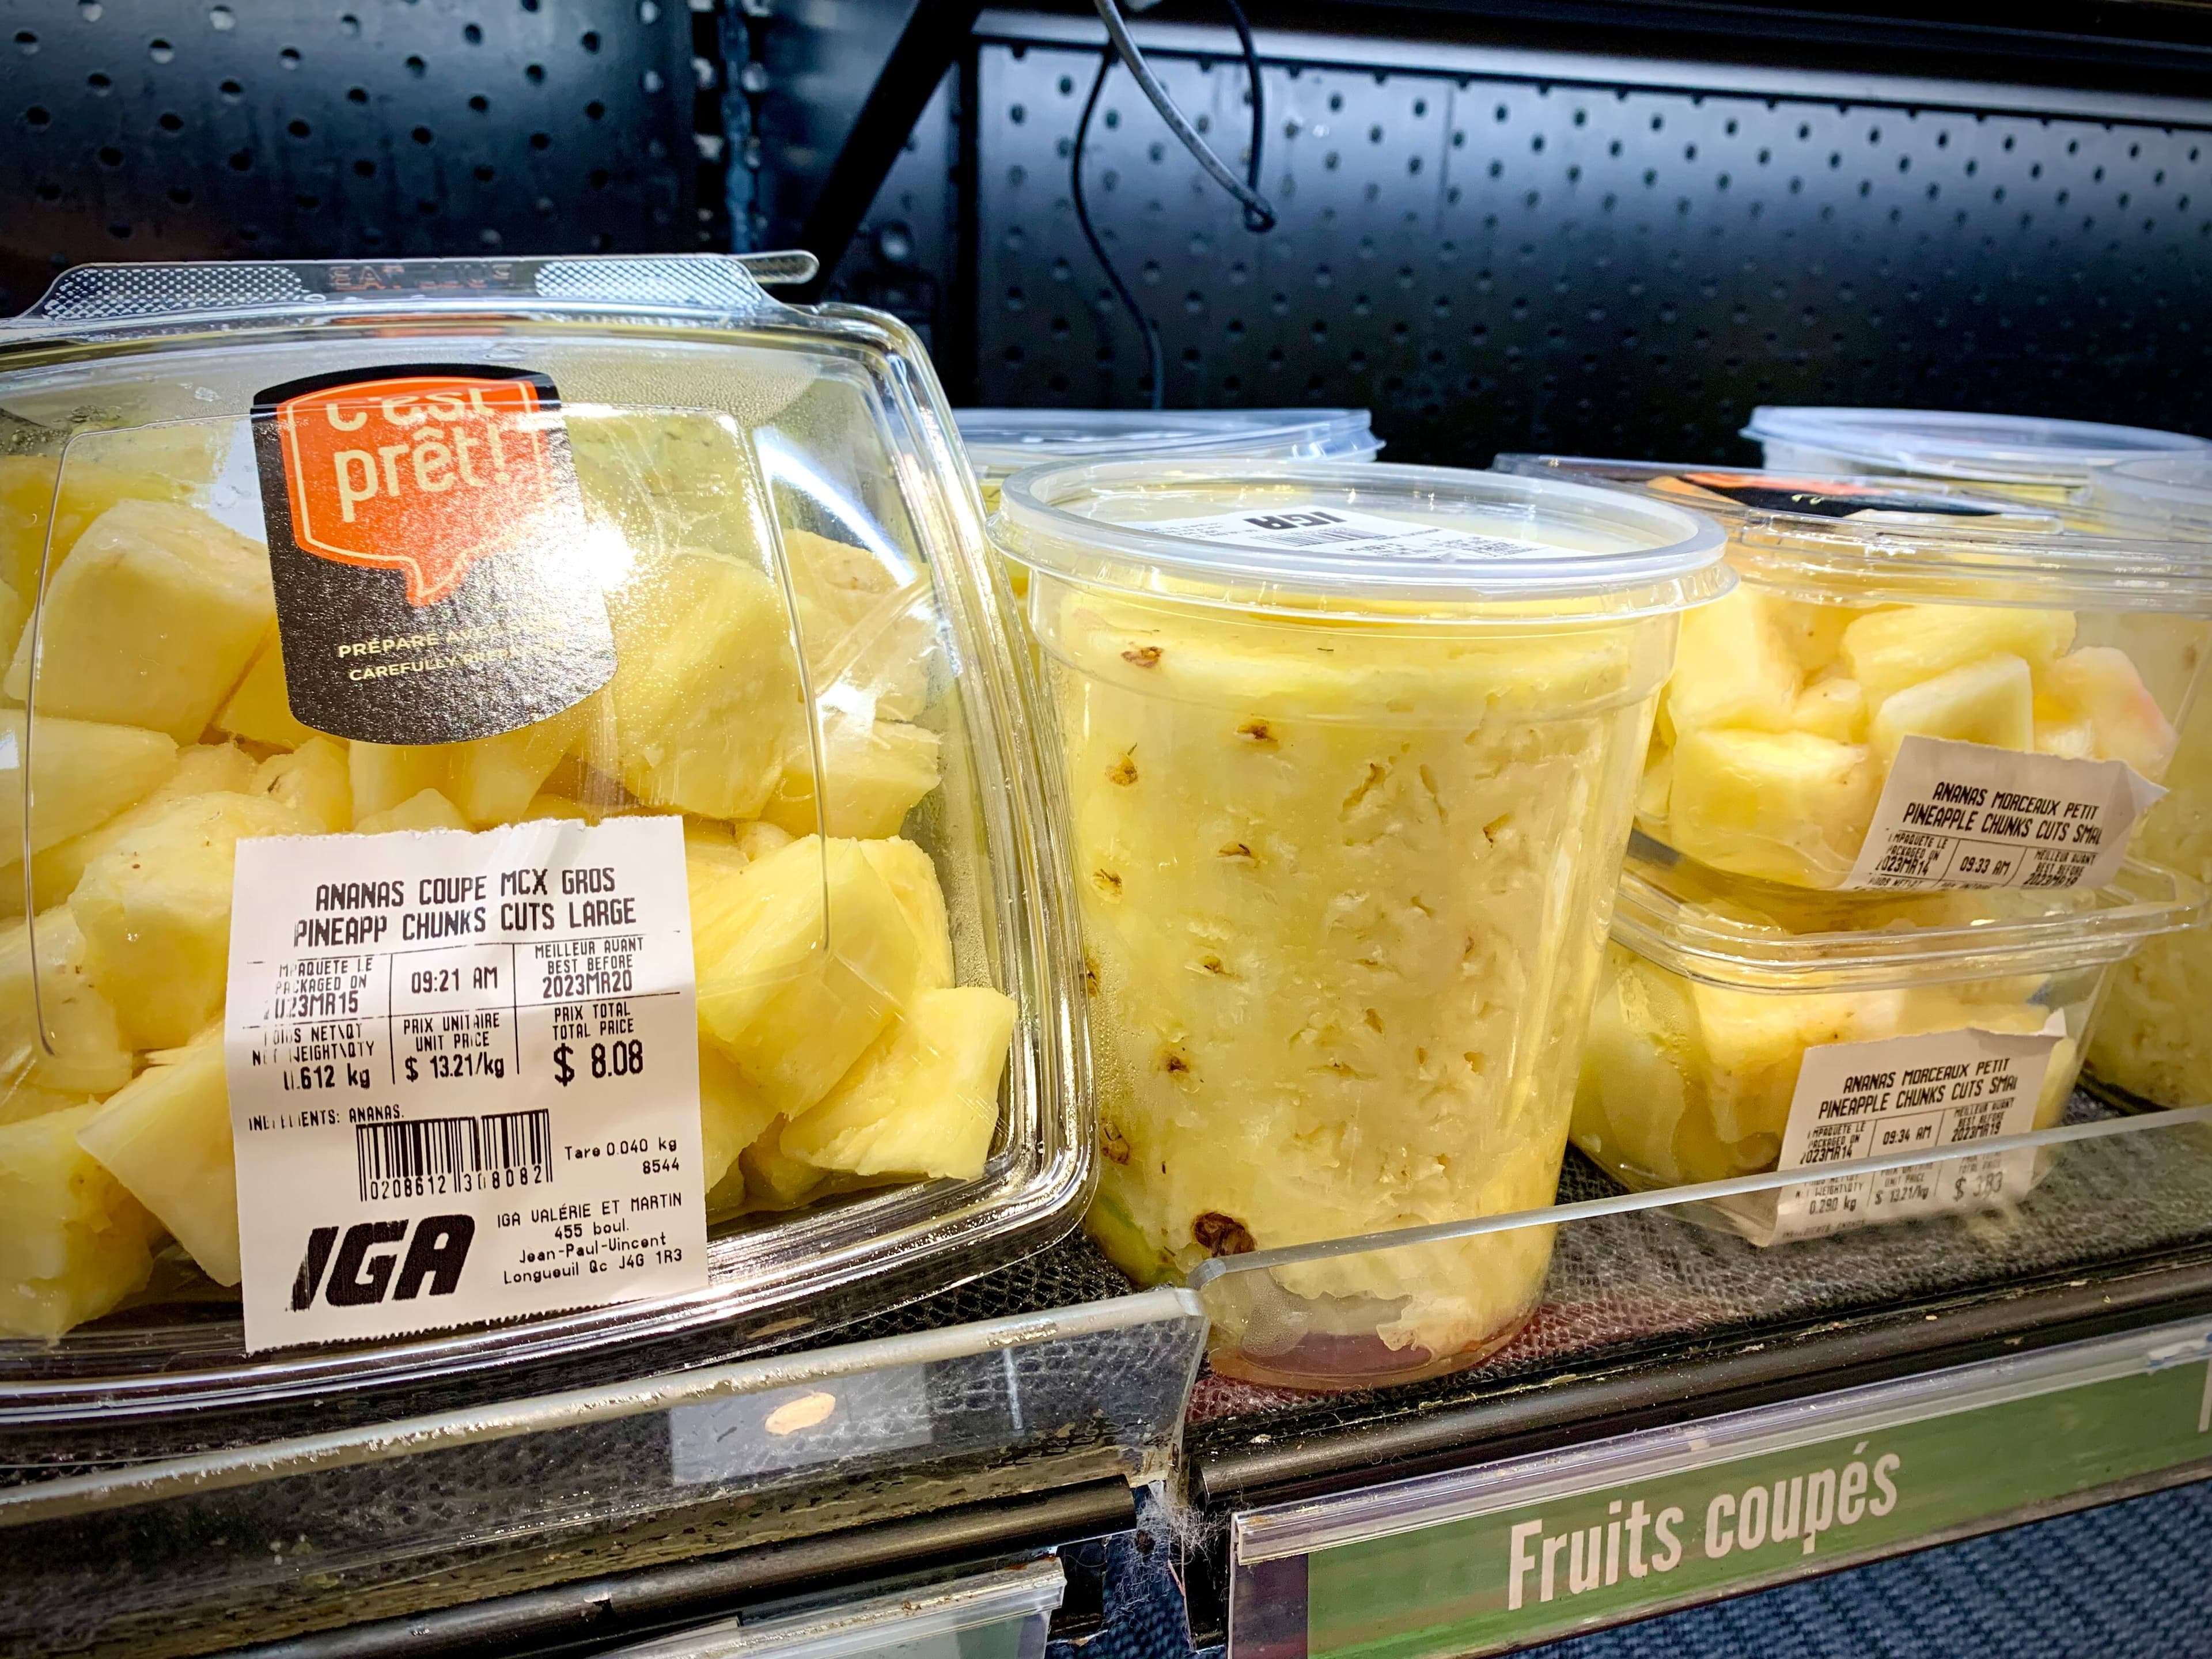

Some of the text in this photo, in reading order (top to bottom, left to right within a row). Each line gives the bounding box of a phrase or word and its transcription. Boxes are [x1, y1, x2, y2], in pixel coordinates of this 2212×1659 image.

[334, 423, 512, 523] prêt!
[1243, 511, 1348, 530] IGA
[349, 656, 459, 681] CAREFULLY
[1933, 782, 2100, 820] ANANAS MORCEAUX PETIT
[1903, 802, 1979, 831] PINEAPPLE
[1981, 813, 2033, 838] CHUNKS
[2036, 820, 2070, 842] CUTS
[1937, 838, 1949, 849] LE
[1959, 856, 2012, 876] 09:33 AM
[316, 868, 615, 911] ANANAS COUPE MCX GROS
[294, 897, 636, 948] PINEAPP CHUNKS CUTS LARGE
[535, 937, 643, 959] MEILLEUR AVANT
[548, 955, 633, 975] BEST BEFORE
[275, 974, 367, 994] PACKAGED ON
[411, 967, 497, 993] 09:21 AM
[543, 969, 632, 999] 2023MR20
[404, 1013, 499, 1035] PRIX UNITAIRE
[555, 1001, 631, 1022] PRIX TOTAL
[552, 1018, 634, 1040] TOTAL PRICE
[416, 1032, 490, 1052] UNIT PRICE
[405, 1052, 504, 1082] $ 13.21/kg
[554, 1039, 643, 1087] $ 8.08
[283, 1063, 370, 1090] 0.612 kg
[1843, 1058, 2010, 1094] ANANAS MORCEAUX PETIT
[1818, 1092, 1891, 1119] PINEAPPLE
[1896, 1085, 1946, 1109] CHUNKS
[1951, 1079, 1984, 1100] CUTS
[349, 1104, 404, 1123] ANANAS.
[1808, 1136, 1846, 1149] PACKAGED
[1883, 1125, 1932, 1145] 09:34 AM
[565, 1137, 677, 1160] Tare 0.040 kg
[642, 1157, 680, 1174] 8544
[1953, 1176, 1967, 1202] $
[498, 1192, 682, 1228] IGA VALÉRIE ET MARTIN
[1843, 1195, 1857, 1212] kg
[554, 1218, 629, 1240] 455 boul.
[520, 1232, 666, 1263] Jean-Paul-Vincent
[291, 1214, 475, 1312] IGA
[504, 1248, 682, 1285] Longueuil Qc J4G 1R3
[1508, 1440, 1901, 1610] Fruits coupés
